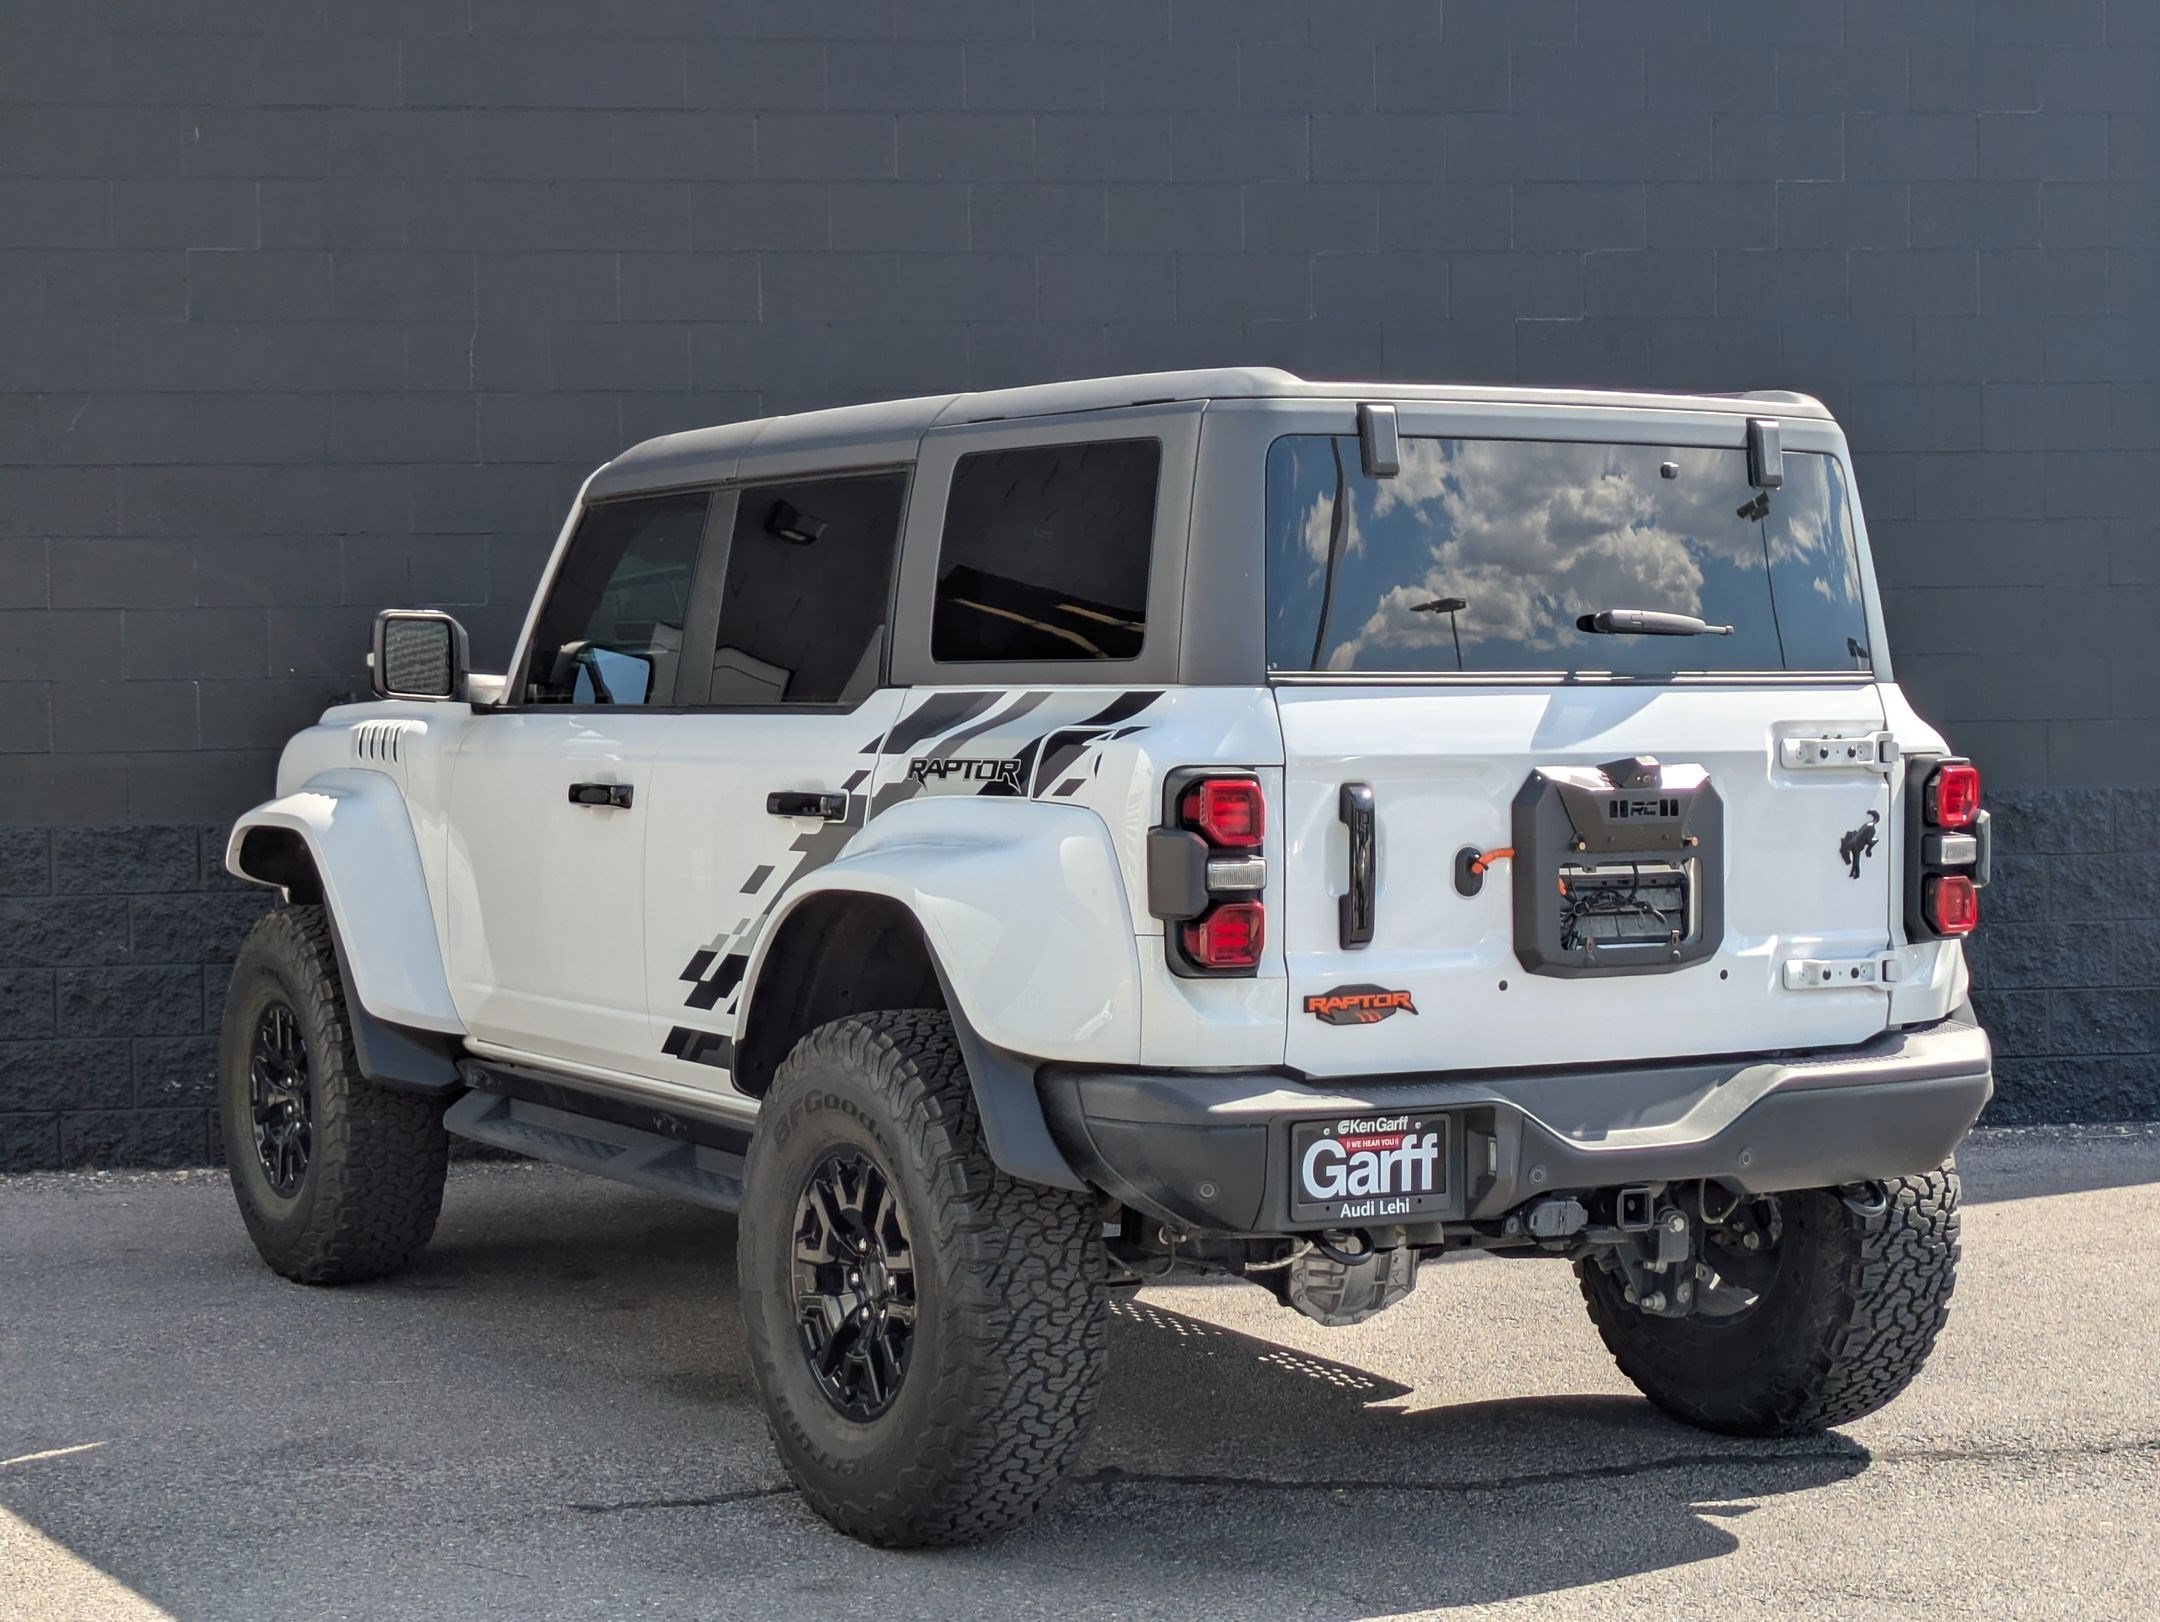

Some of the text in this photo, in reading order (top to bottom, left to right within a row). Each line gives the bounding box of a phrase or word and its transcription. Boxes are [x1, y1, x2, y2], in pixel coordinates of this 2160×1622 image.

[908, 757, 1022, 795] RAPTOR
[1308, 991, 1414, 1015] RAPTOR
[1351, 1138, 1395, 1148] WE HEAR YOU
[1302, 1132, 1438, 1199] Garff
[1340, 1197, 1410, 1219] Audi Lehi
